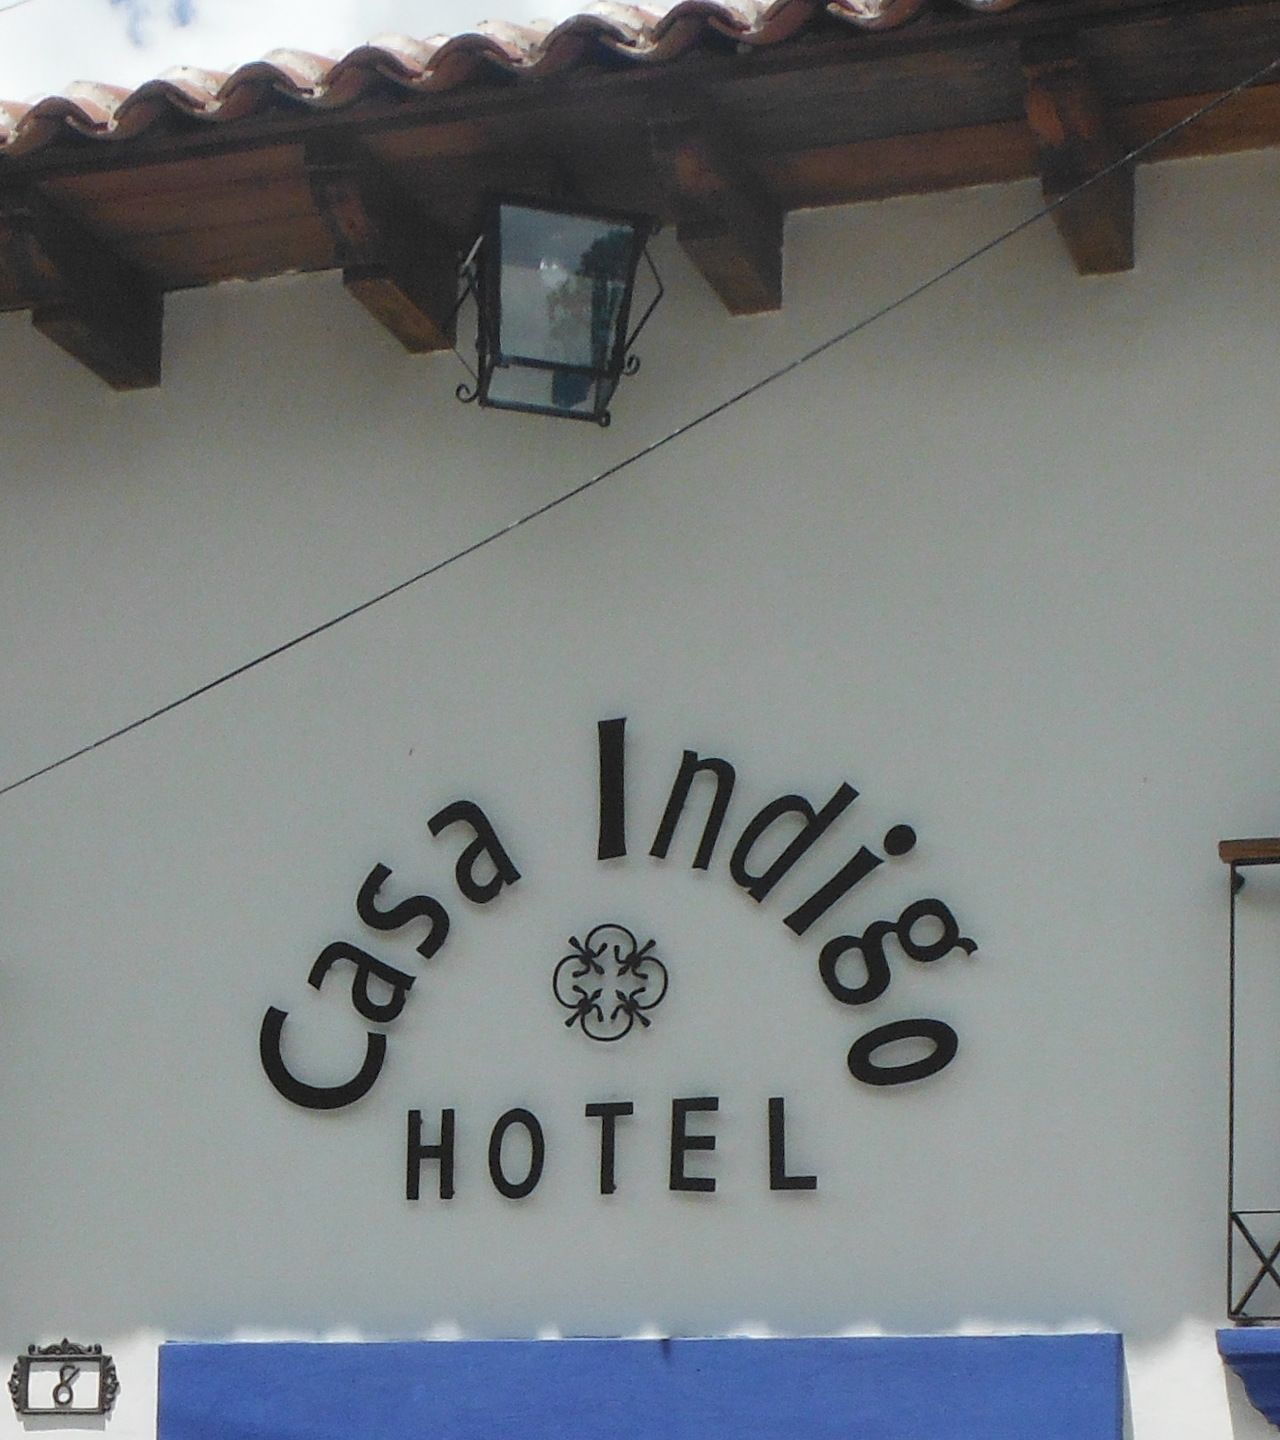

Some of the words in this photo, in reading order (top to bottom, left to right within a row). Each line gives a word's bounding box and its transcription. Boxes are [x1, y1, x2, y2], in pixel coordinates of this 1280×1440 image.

[259, 799, 521, 1110] Casa
[596, 716, 979, 1087] Indigo
[405, 1096, 818, 1200] HOTEL
[52, 1364, 80, 1405] 8
